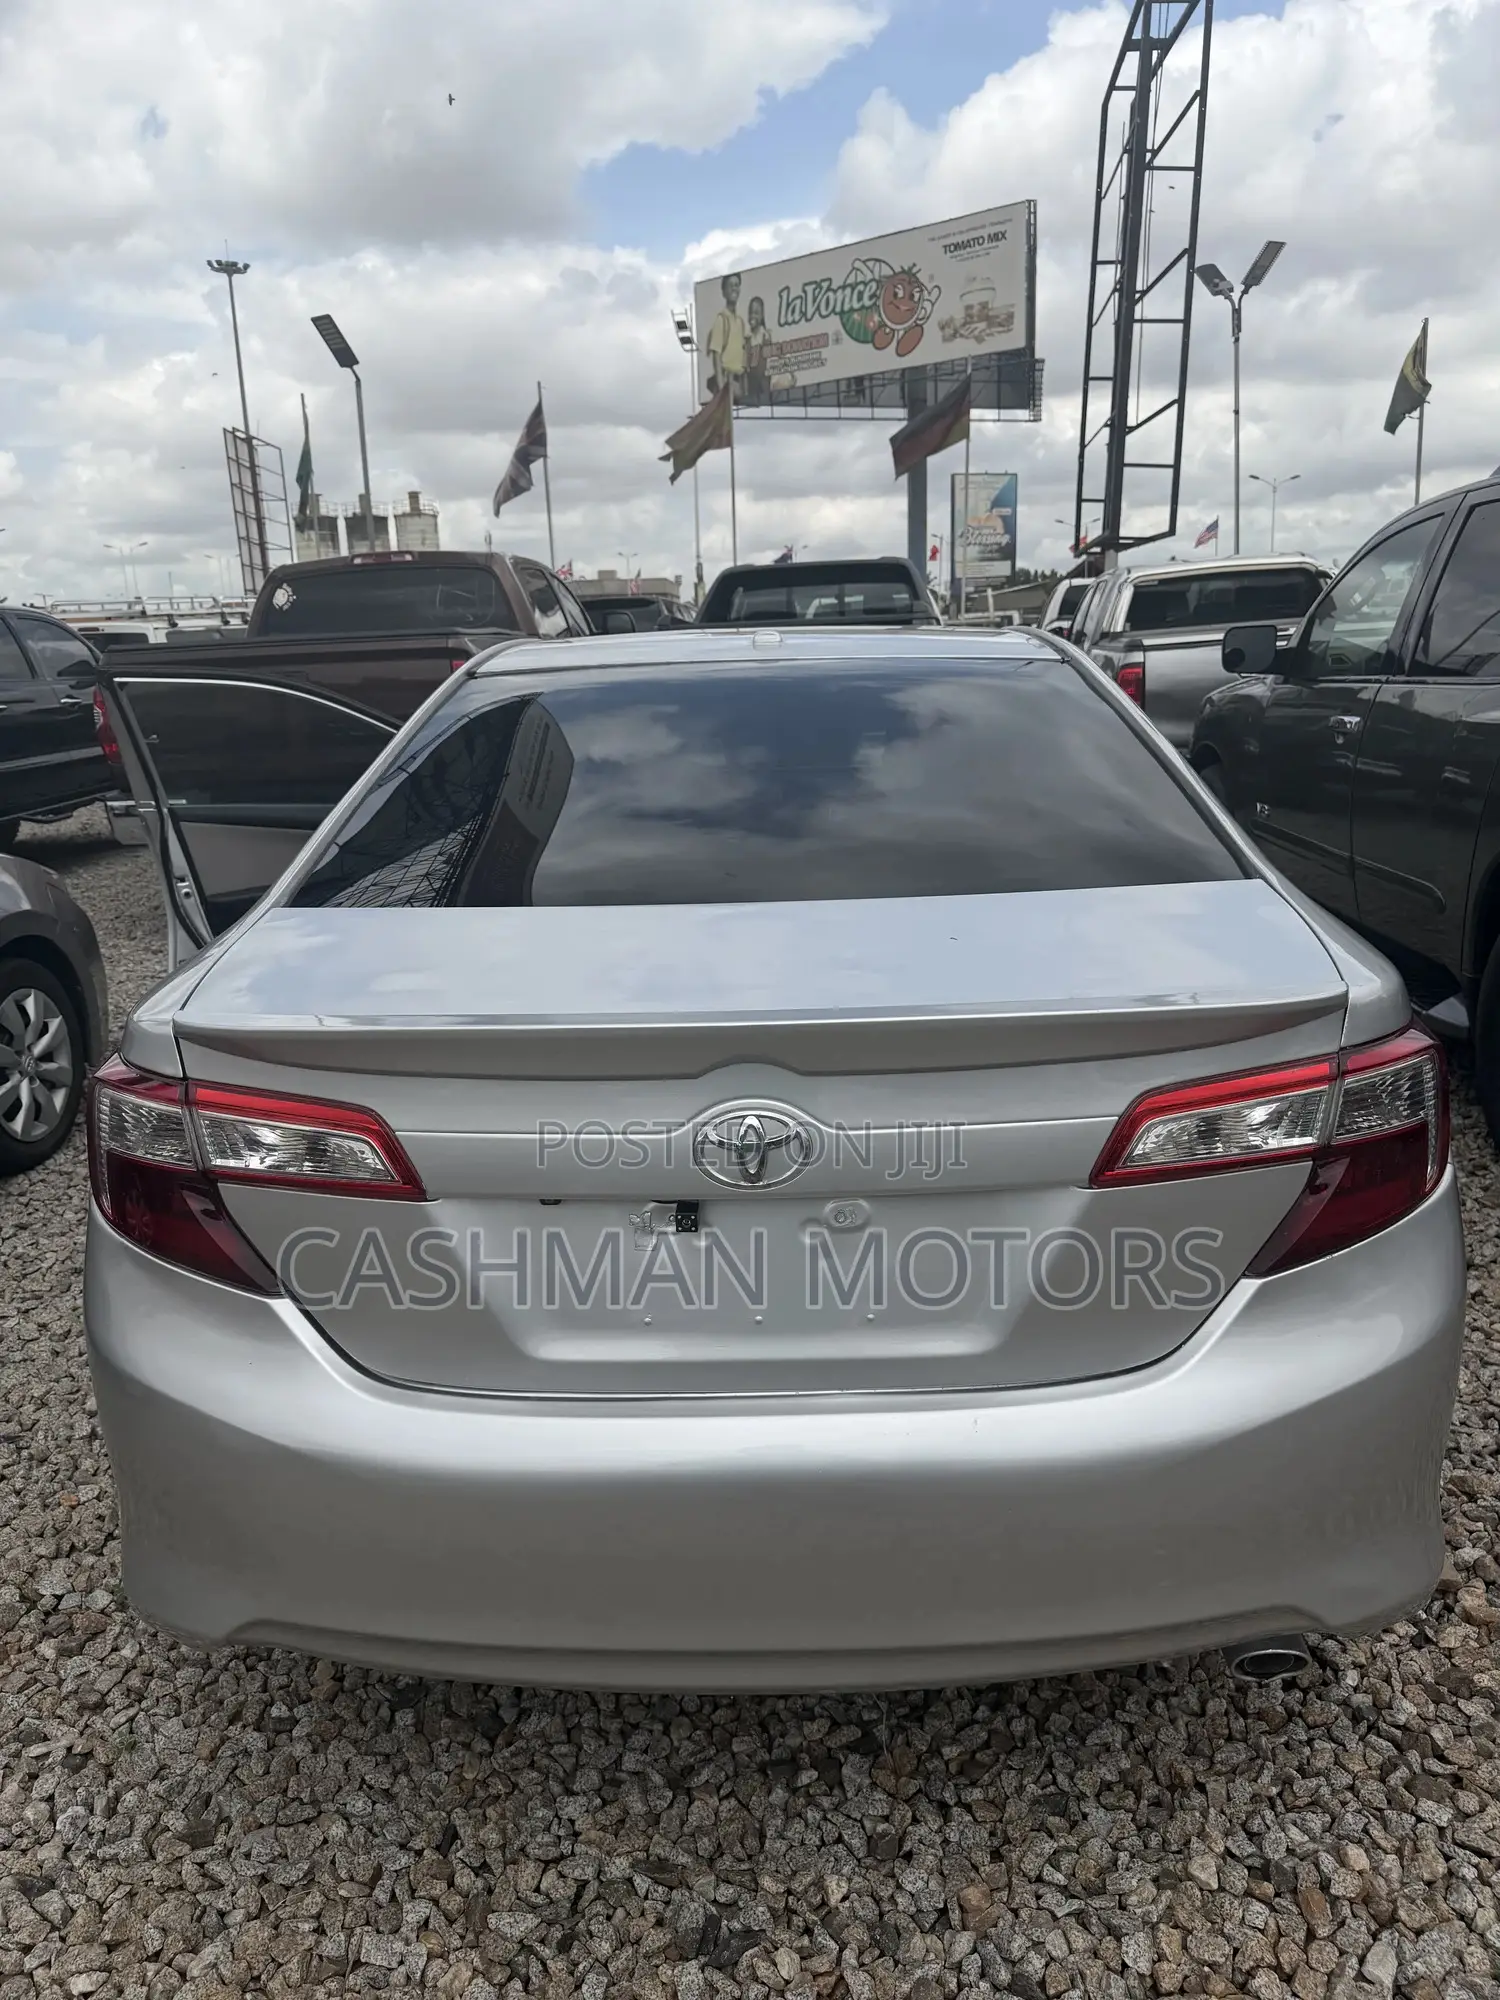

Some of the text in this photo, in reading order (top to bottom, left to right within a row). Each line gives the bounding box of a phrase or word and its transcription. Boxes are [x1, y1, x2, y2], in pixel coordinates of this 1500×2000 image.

[942, 235, 985, 255] TOMATO
[986, 229, 1008, 245] MIX
[778, 277, 879, 327] laVonce
